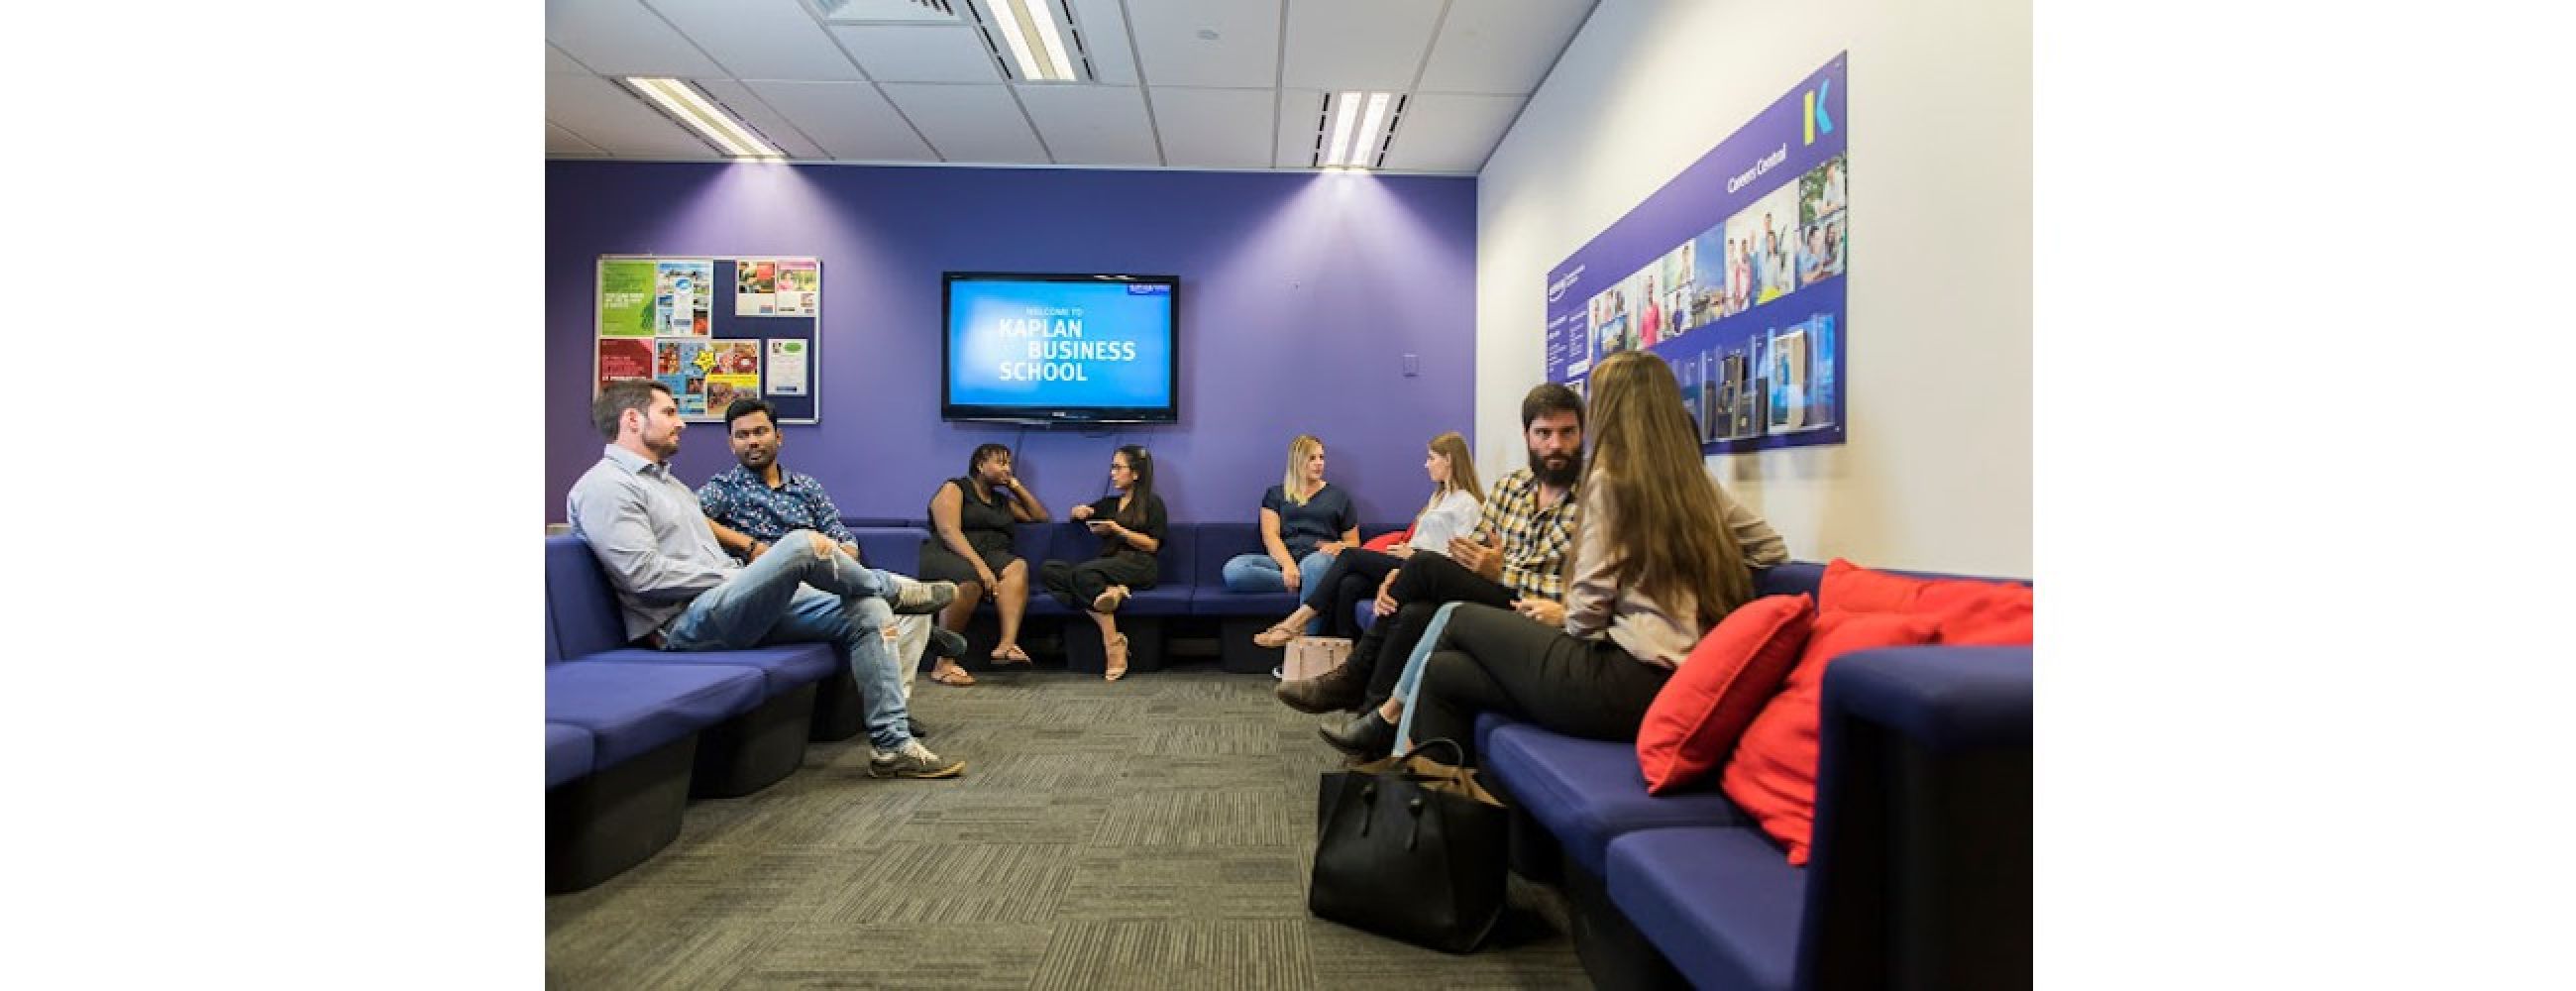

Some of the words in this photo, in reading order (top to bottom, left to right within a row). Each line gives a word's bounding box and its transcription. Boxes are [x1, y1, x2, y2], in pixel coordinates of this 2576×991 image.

[999, 318, 1083, 338] KAPLAN
[1027, 340, 1136, 361] BUSINESS
[999, 362, 1089, 382] SCHOOL
